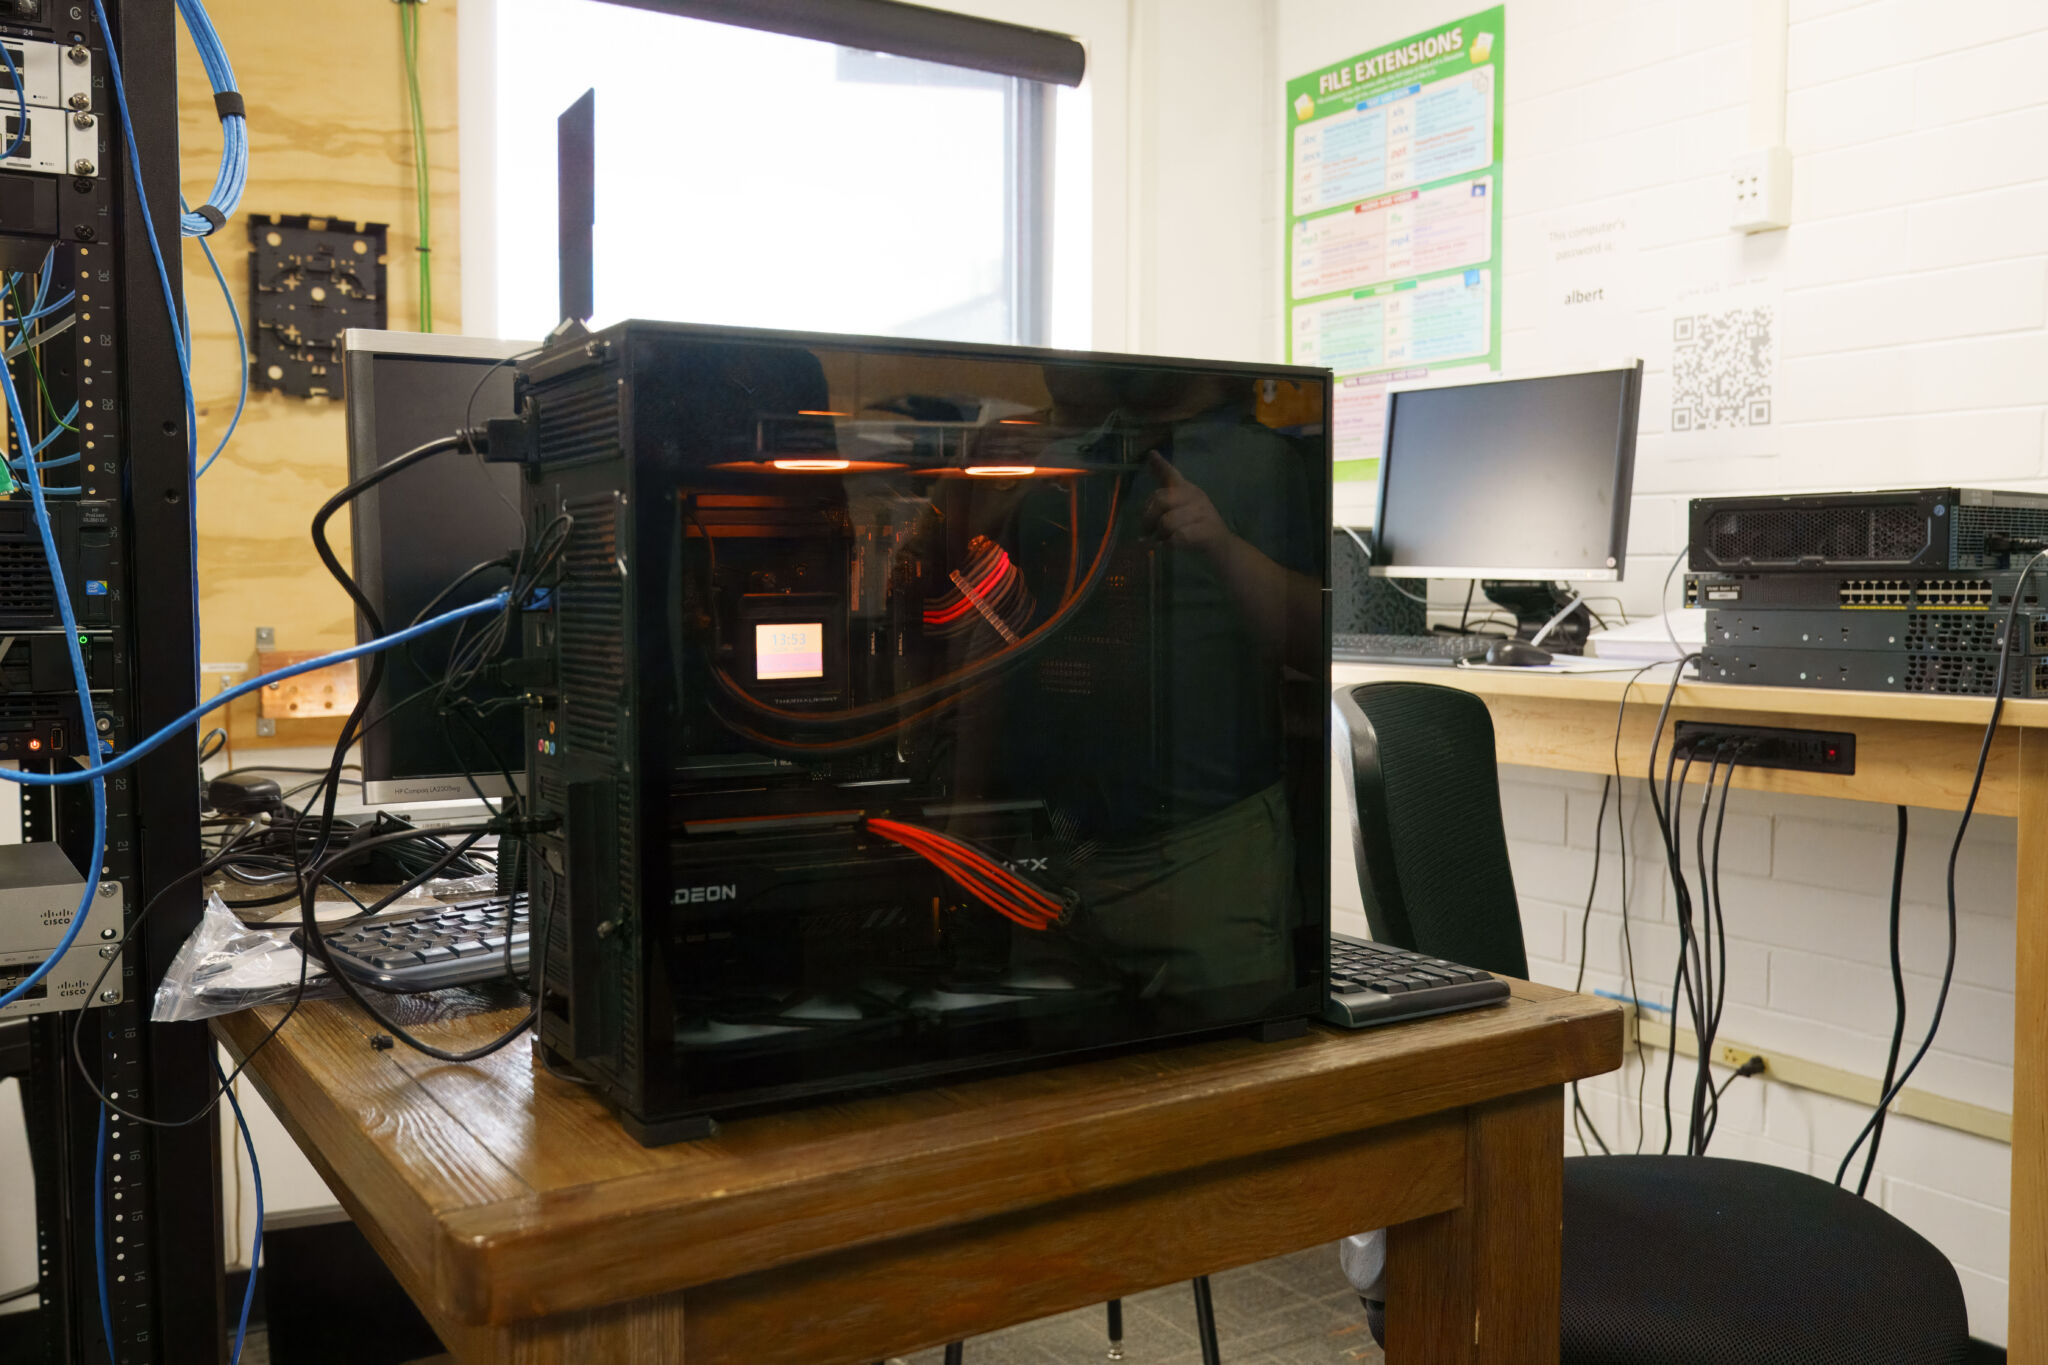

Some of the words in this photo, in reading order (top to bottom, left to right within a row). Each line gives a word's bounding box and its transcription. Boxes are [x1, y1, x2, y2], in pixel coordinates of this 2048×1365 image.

[23, 28, 33, 37] 24
[1318, 66, 1352, 96] FILE
[1354, 27, 1464, 83] EXTENSIONS
[92, 75, 104, 88] 33
[1549, 231, 1566, 240] This
[1568, 217, 1625, 239] computer's
[1555, 243, 1601, 262] password
[98, 269, 110, 282] 30
[1564, 287, 1605, 306] albert
[100, 334, 111, 346] 29
[102, 398, 114, 411] 28
[104, 462, 116, 474] 27
[773, 633, 806, 646] 13:53
[115, 778, 126, 791] 22
[404, 787, 428, 795] Compaq
[118, 841, 129, 852] 21
[670, 884, 736, 904] DEON
[43, 917, 71, 926] CISCO
[60, 988, 87, 997] CISCO
[125, 1027, 136, 1039] 18
[127, 1088, 138, 1099] 17
[129, 1149, 141, 1161] 16
[132, 1210, 143, 1222] 15
[135, 1270, 146, 1282] 14
[136, 1331, 148, 1343] 13
